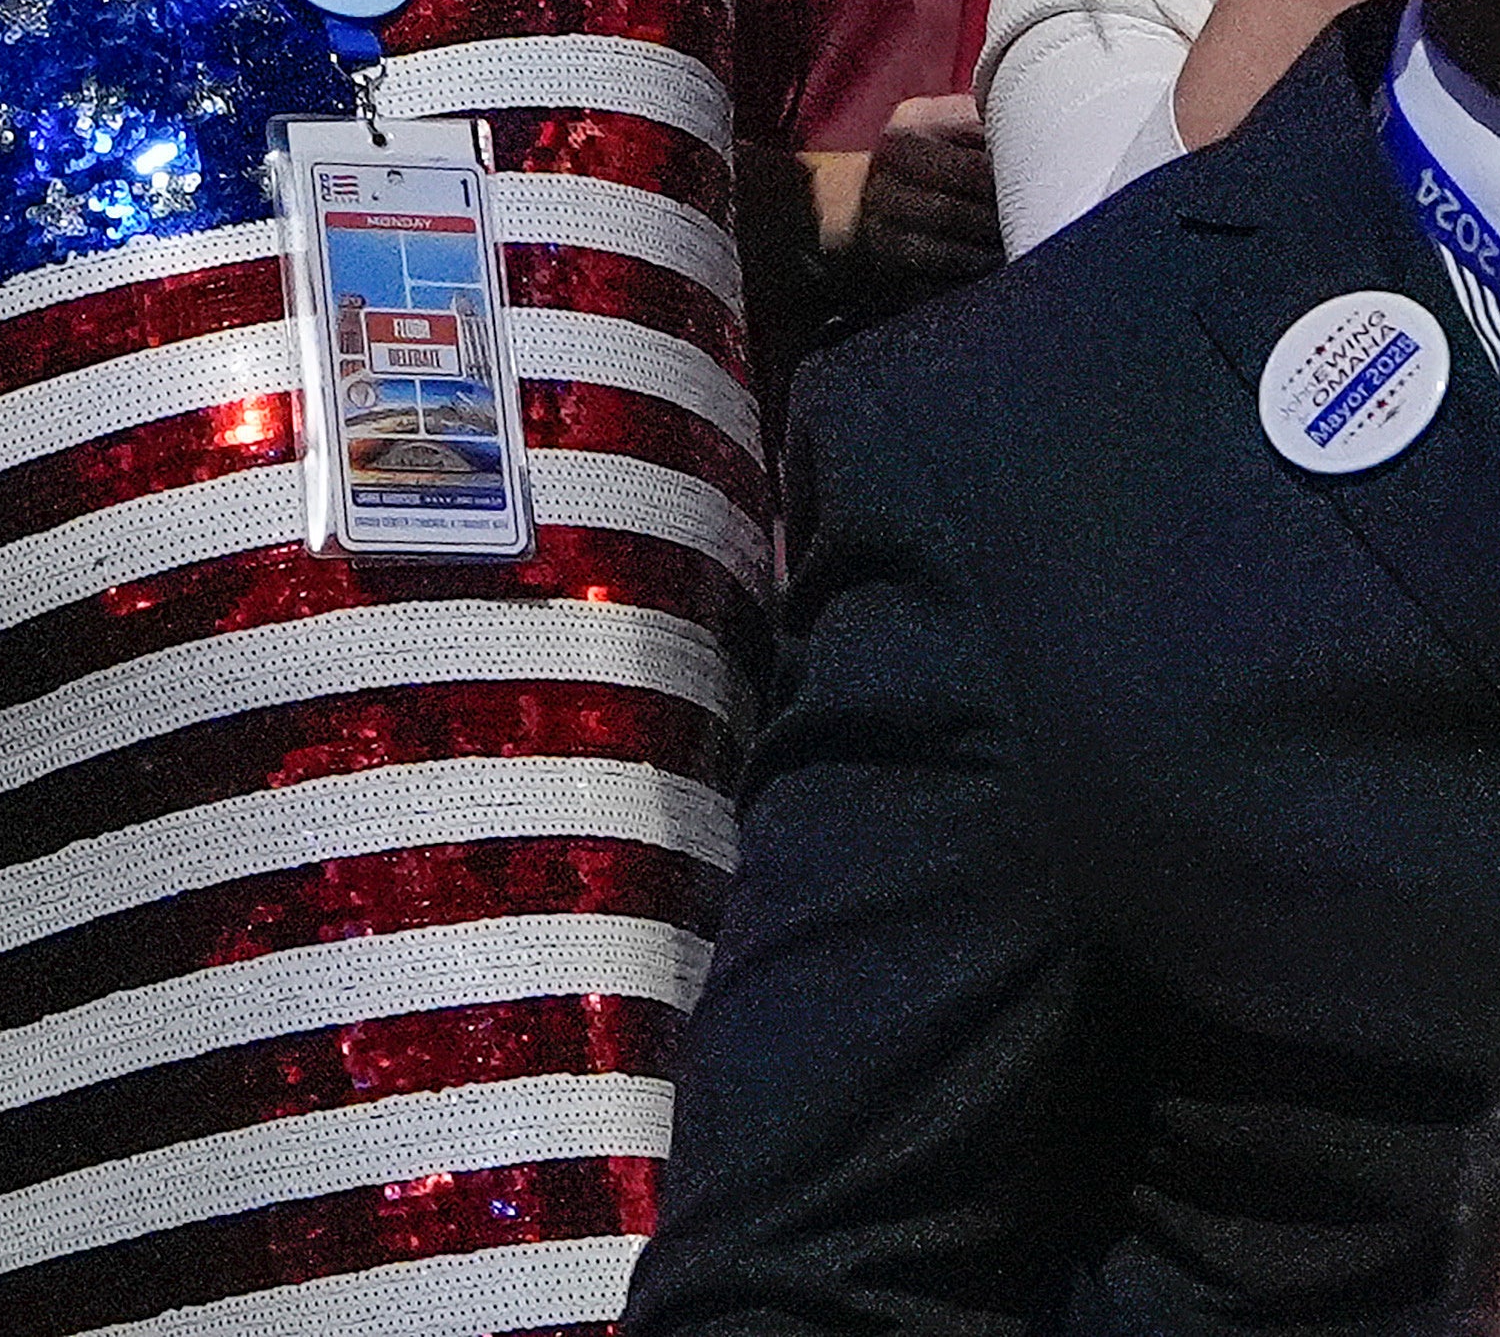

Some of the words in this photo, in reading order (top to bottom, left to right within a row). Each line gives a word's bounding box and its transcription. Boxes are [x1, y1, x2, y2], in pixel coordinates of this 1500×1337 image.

[366, 215, 432, 230] MONDAY
[460, 178, 472, 208] 1
[1416, 167, 1500, 276] 2024
[1312, 324, 1397, 408] OMAHA
[1313, 310, 1387, 385] EWING
[1309, 382, 1370, 445] Mayor
